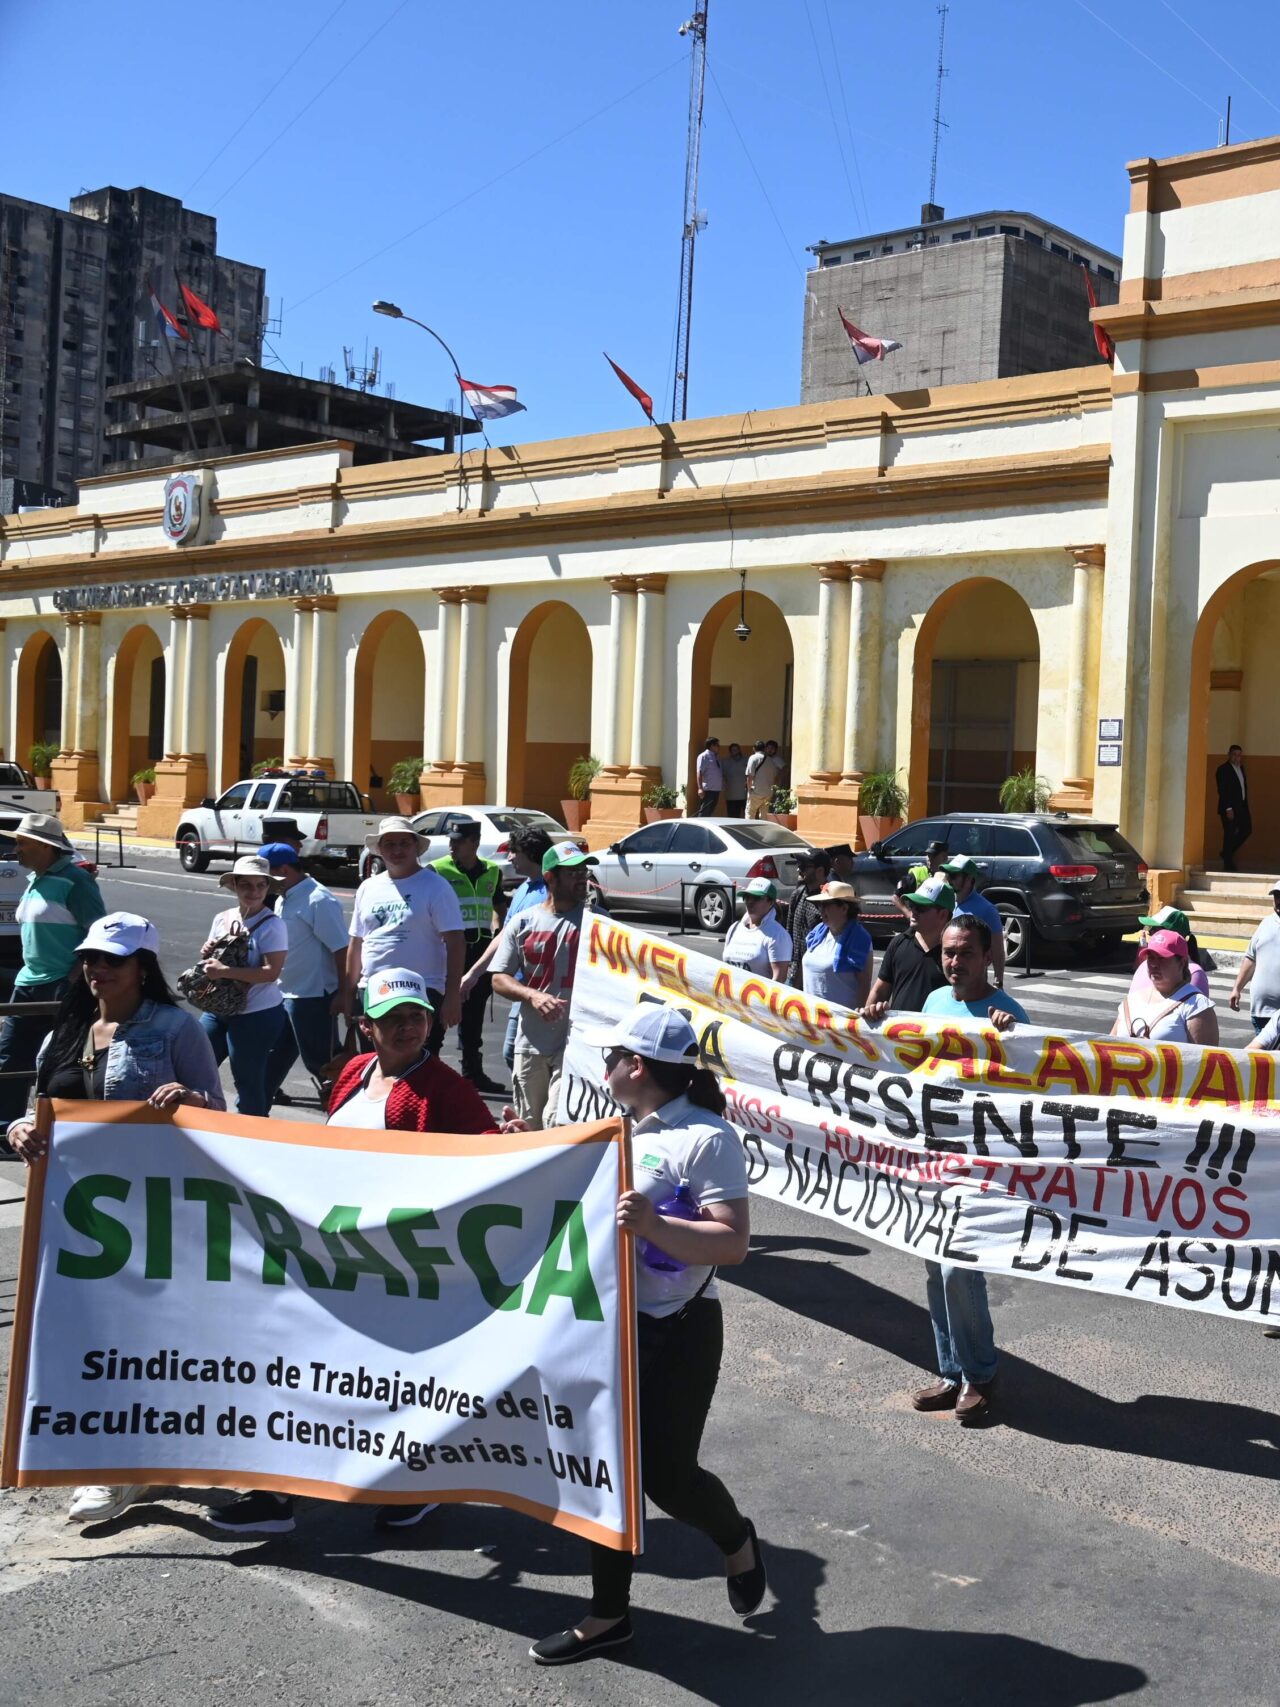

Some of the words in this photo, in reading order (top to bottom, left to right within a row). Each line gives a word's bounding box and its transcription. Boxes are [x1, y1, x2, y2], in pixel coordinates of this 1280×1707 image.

[371, 904, 386, 914] LA
[387, 902, 409, 913] UNA
[588, 918, 881, 1061] NIVELACION
[773, 1043, 1160, 1168] PRESENTE
[1183, 1119, 1256, 1187] !!!
[56, 1174, 605, 1322] SITRAFCA
[779, 1142, 978, 1263] NACIONAL
[1011, 1205, 1108, 1281] DE
[29, 1402, 205, 1436] Facultad
[217, 1406, 257, 1438] de
[267, 1410, 385, 1456] Ciencias
[389, 1430, 527, 1472] Agrarias
[547, 1447, 613, 1493] UNA
[81, 1348, 256, 1384] Sindicato
[266, 1356, 300, 1389] de
[310, 1361, 488, 1418] Trabajadores
[496, 1391, 538, 1421] de
[543, 1395, 574, 1429] la
